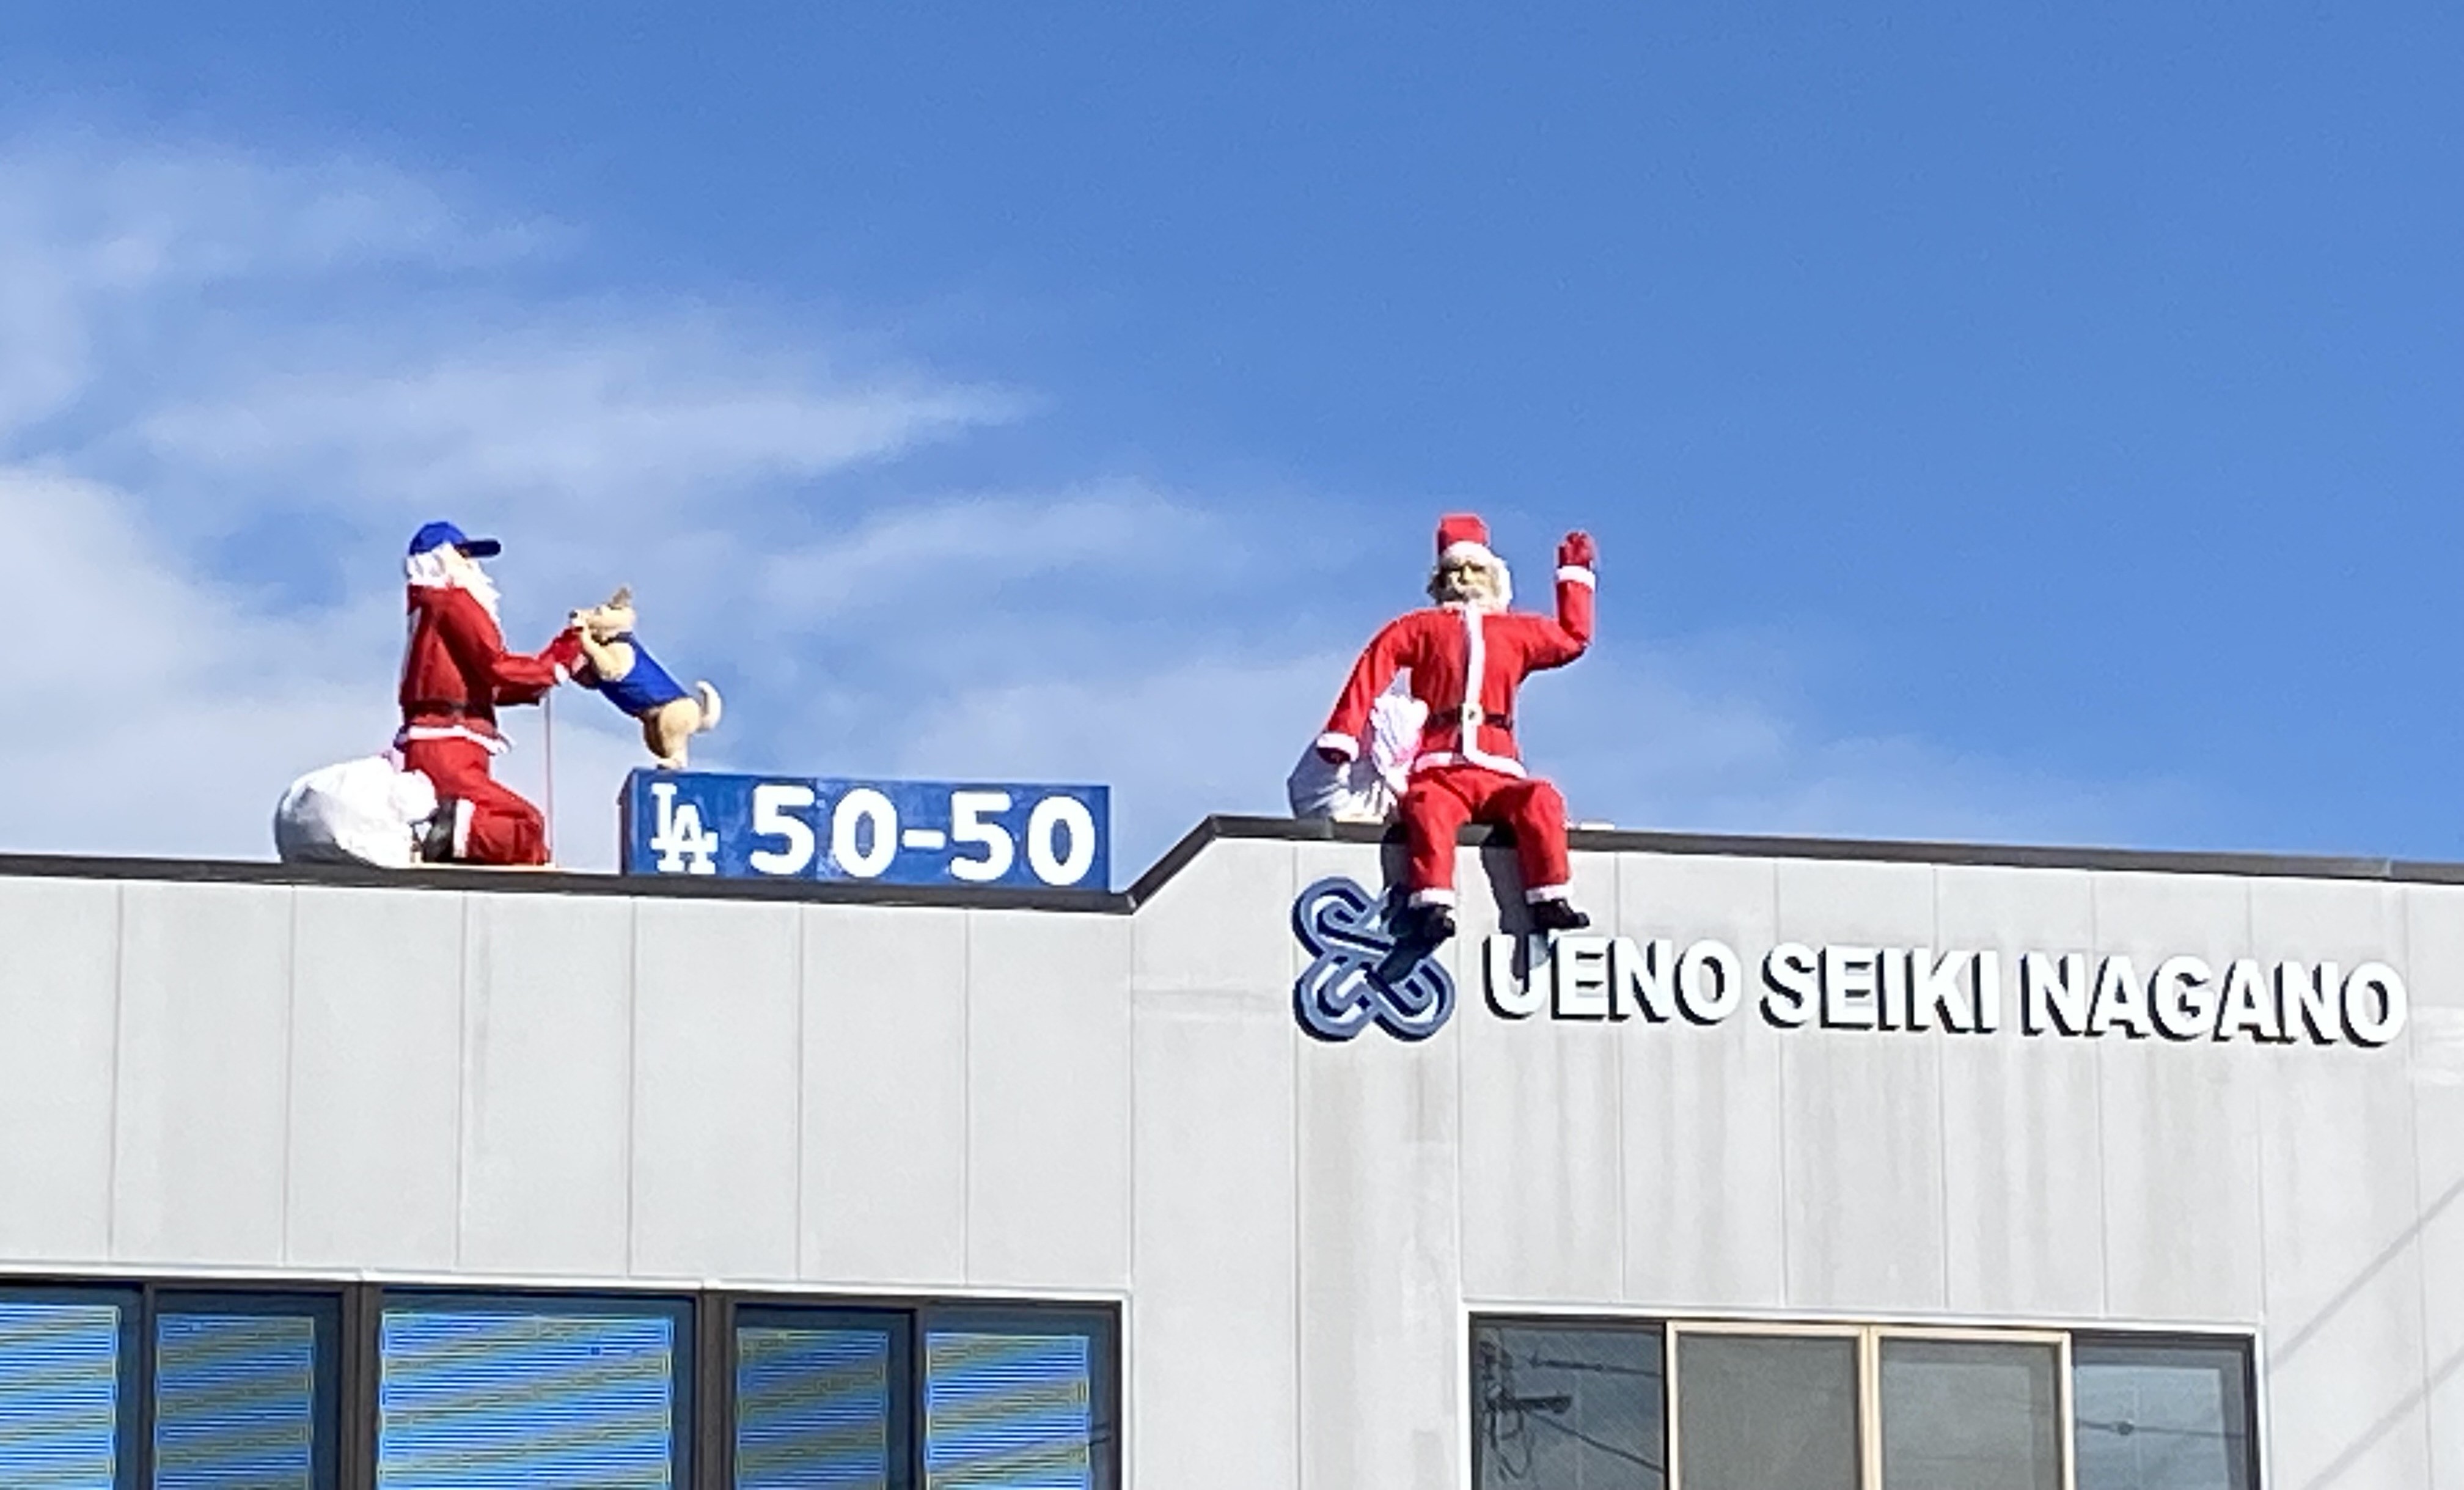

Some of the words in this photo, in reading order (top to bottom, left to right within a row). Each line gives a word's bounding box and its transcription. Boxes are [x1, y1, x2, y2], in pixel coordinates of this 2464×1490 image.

[651, 782, 718, 875] LA
[750, 784, 1096, 886] 50-50
[1483, 934, 1742, 1024] UENO
[1760, 942, 1999, 1033] SEIKI
[2020, 952, 2408, 1047] NAGANO
